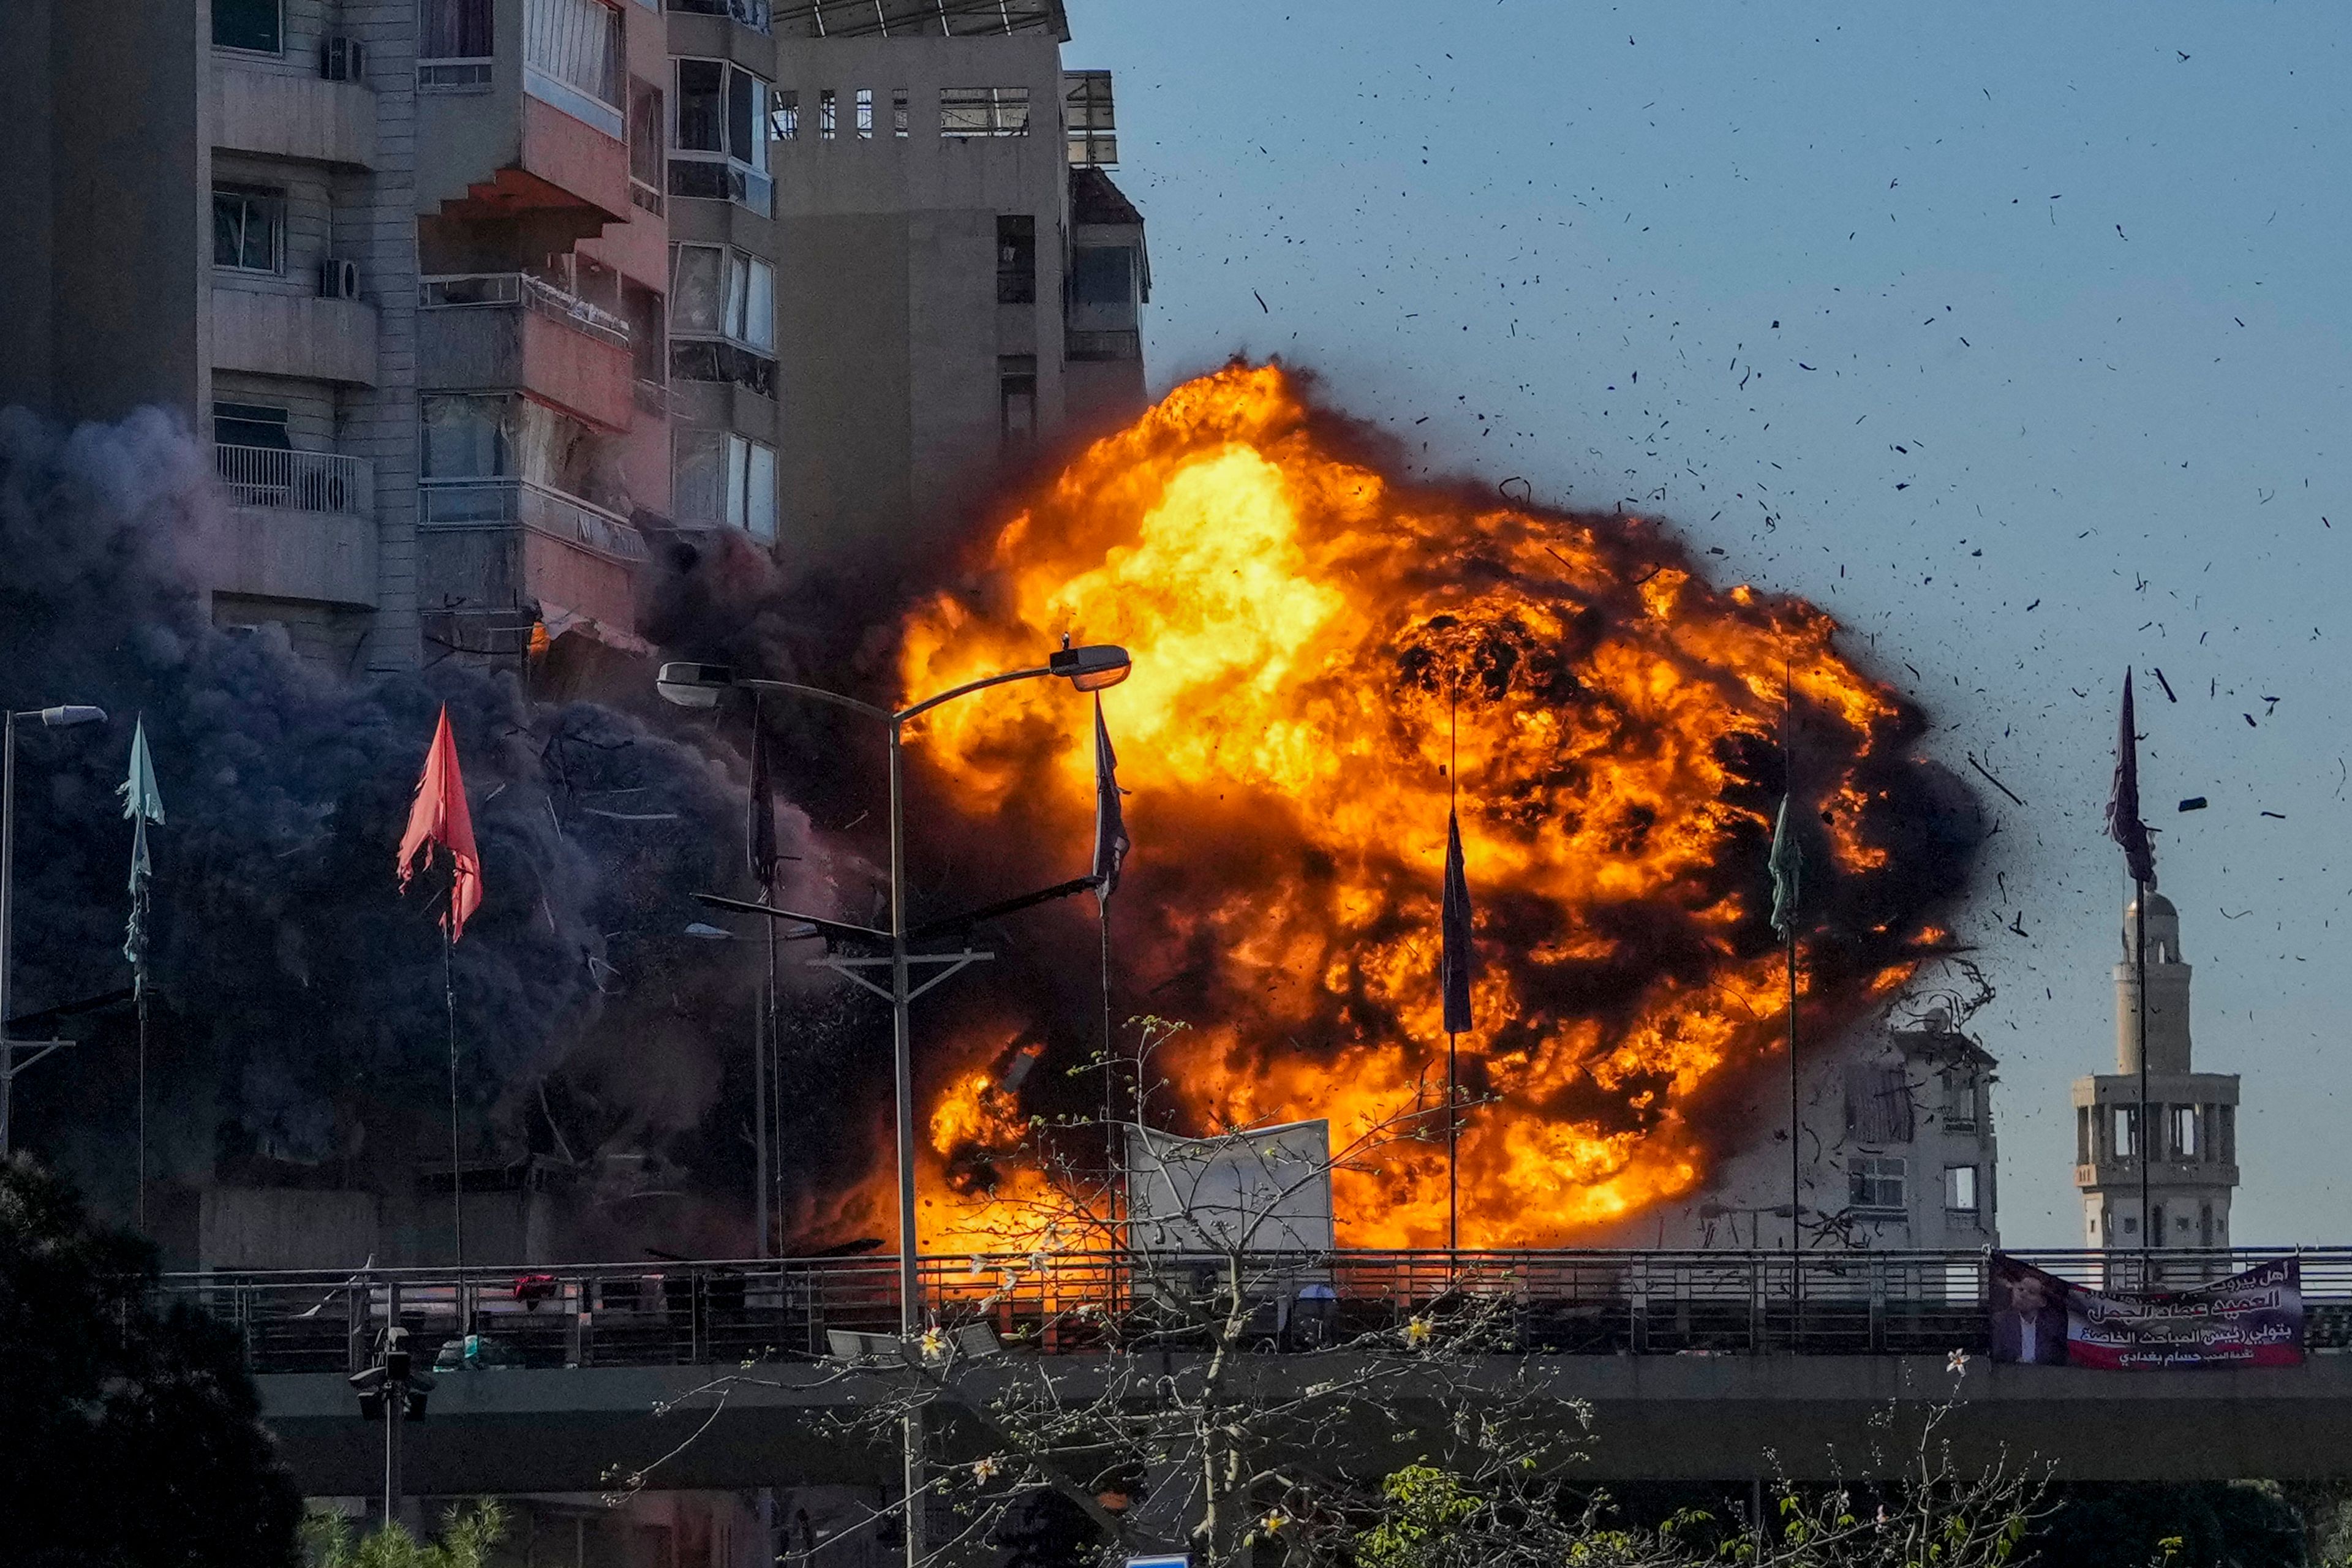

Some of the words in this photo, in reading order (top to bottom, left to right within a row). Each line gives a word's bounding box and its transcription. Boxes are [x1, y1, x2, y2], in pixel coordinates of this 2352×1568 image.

[2260, 1261, 2289, 1286] أهل
[2211, 1288, 2282, 1319] العميد
[2081, 1327, 2136, 1343] الخاصة
[2139, 1328, 2200, 1347] المباحث
[2203, 1325, 2247, 1346] رئيس
[2119, 1351, 2162, 1366] بغدادي
[2164, 1352, 2202, 1366] حسام
